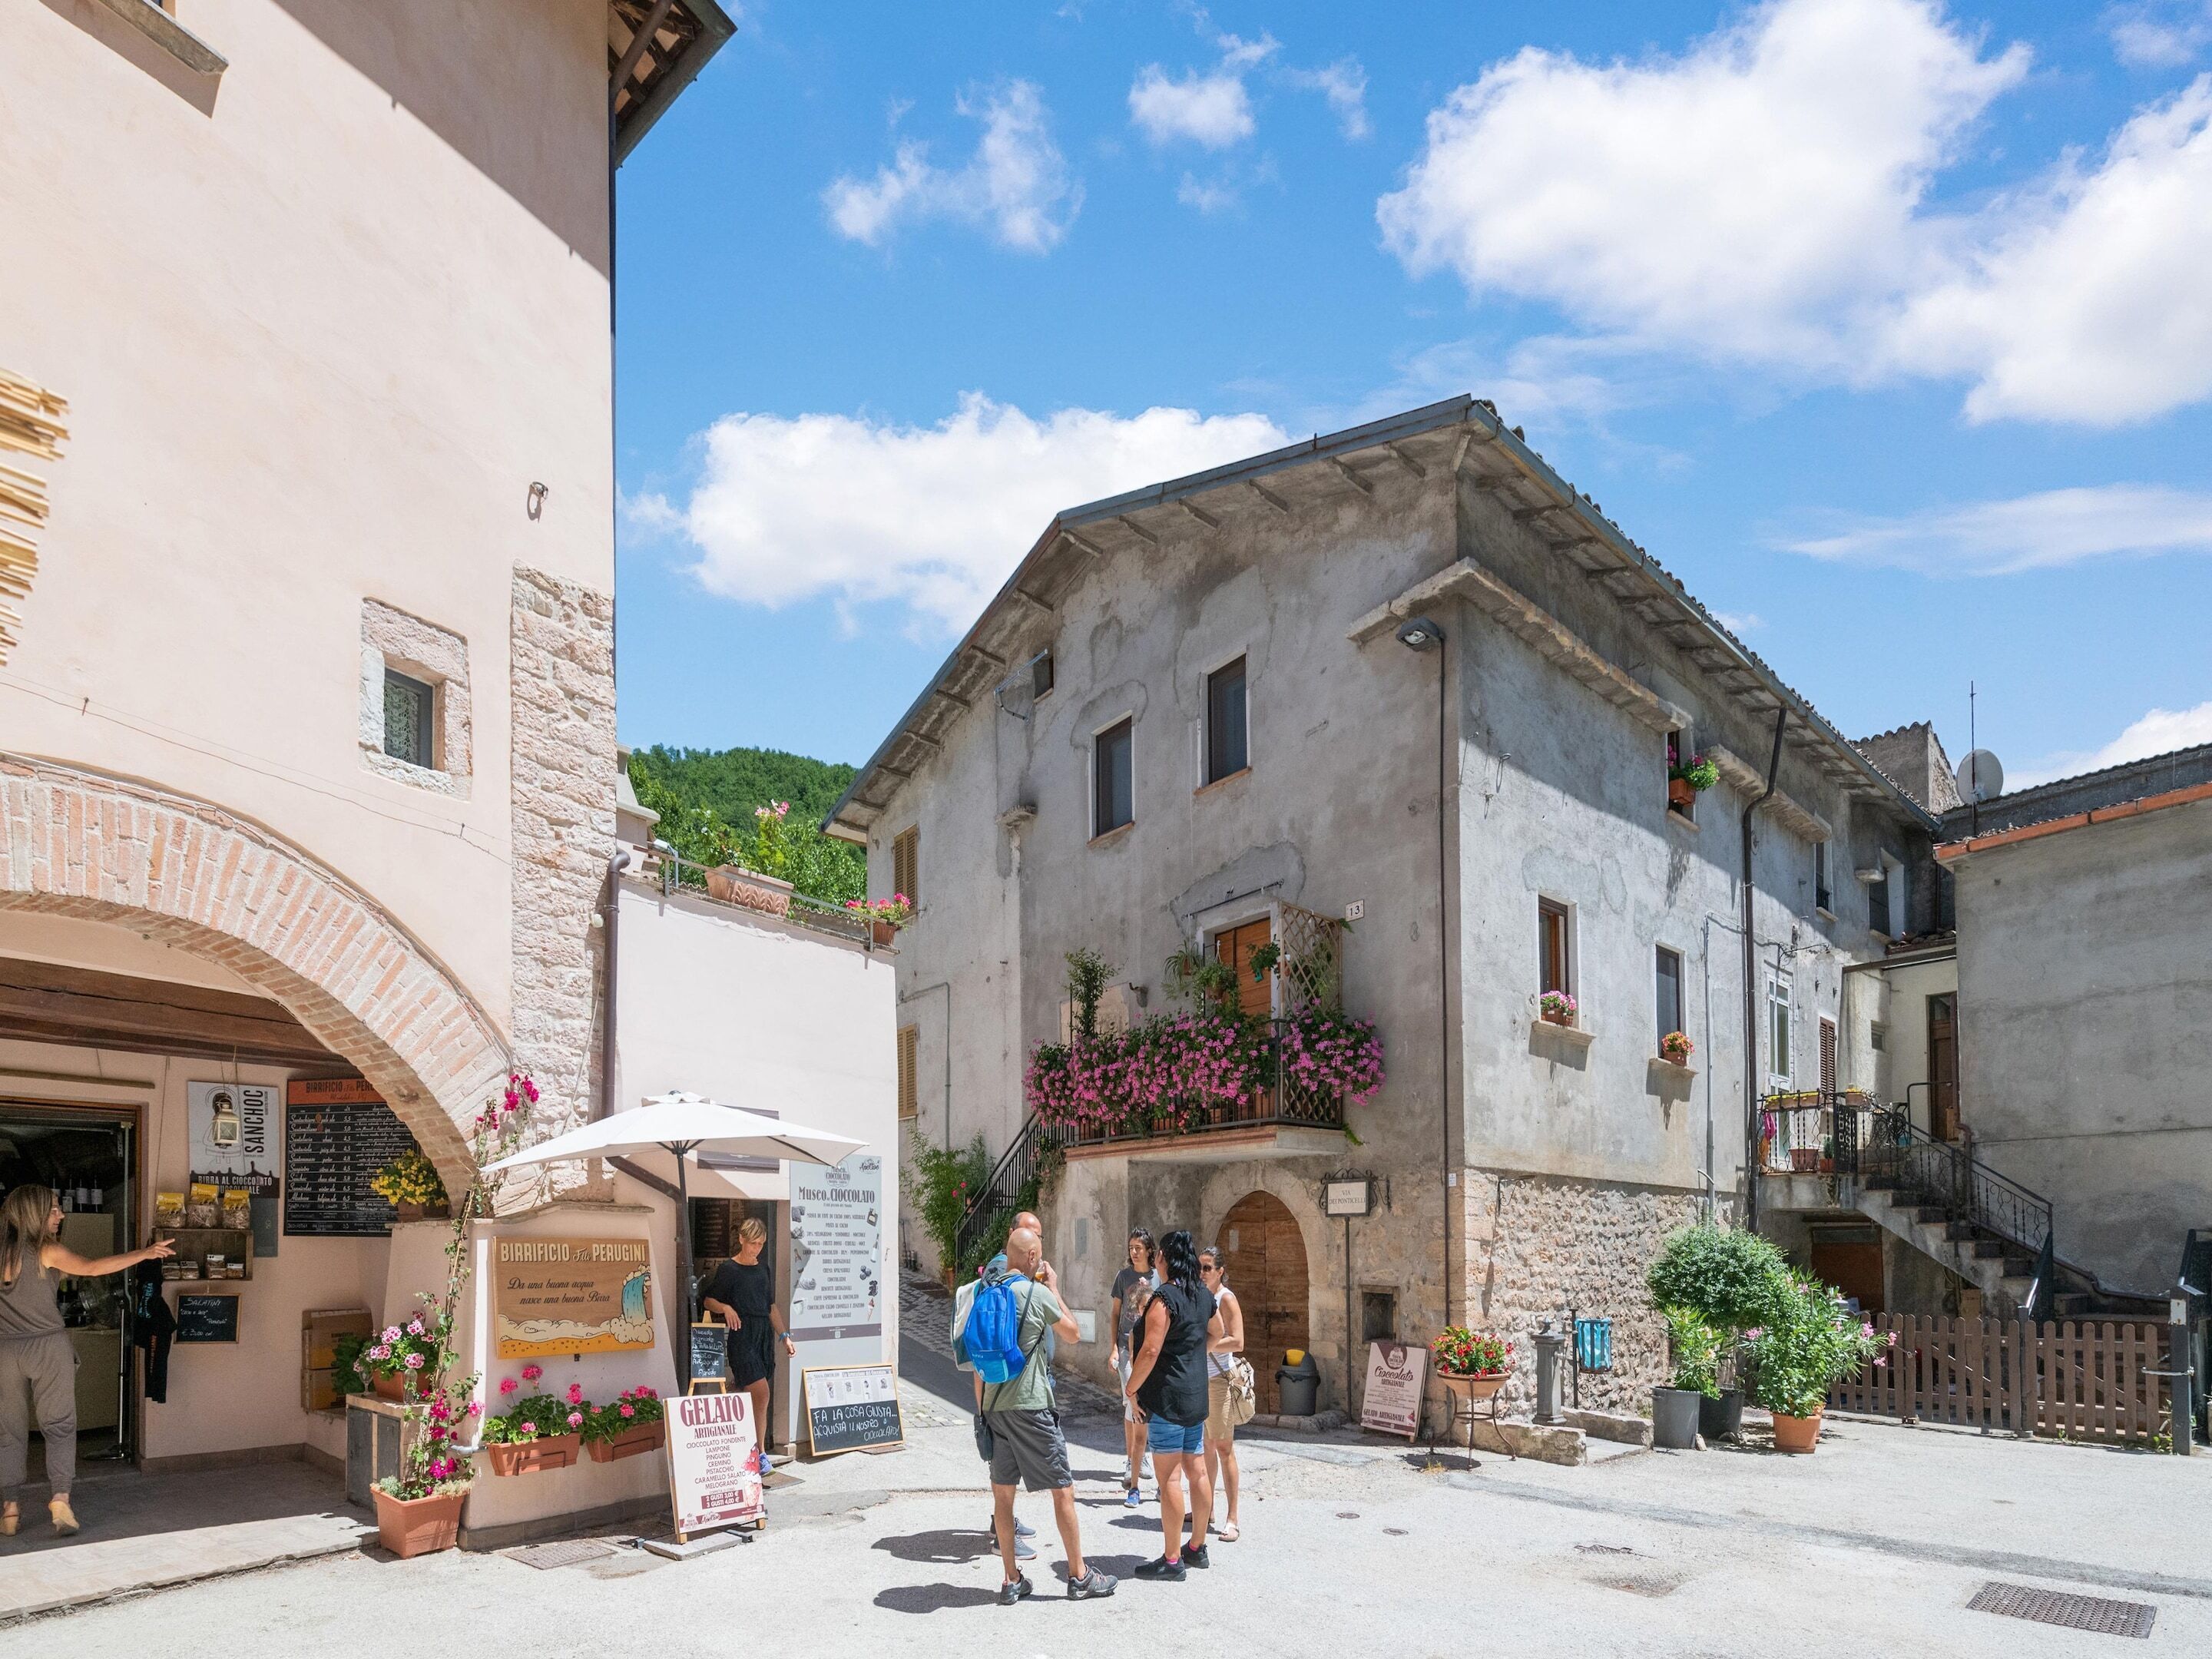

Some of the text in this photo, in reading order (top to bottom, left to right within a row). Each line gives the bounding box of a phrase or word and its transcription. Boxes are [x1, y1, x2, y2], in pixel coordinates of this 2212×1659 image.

[1349, 905, 1360, 916] 13
[306, 1081, 343, 1094] BIRRIFICIO
[243, 1089, 264, 1154] SANCHOC
[197, 1175, 219, 1184] BIRRA
[222, 1176, 230, 1185] AL
[830, 1187, 875, 1204] CIOCCOLATO
[1337, 1197, 1366, 1205] PONTICELLI
[501, 1242, 570, 1263] BIRRIFICIO
[591, 1243, 646, 1263] PERUGINI
[507, 1277, 594, 1291] Da una buona acqua
[519, 1290, 611, 1305] nasce una buona Birra
[1374, 1365, 1414, 1382] Cioccolato
[680, 1395, 744, 1427] GELATO
[813, 1409, 828, 1424] FA
[833, 1408, 843, 1421] LA
[845, 1406, 864, 1419] COSA
[1363, 1408, 1378, 1417] GELATO
[1379, 1411, 1405, 1422] ARTIGIANALE
[694, 1424, 737, 1439] ARTIGIANALE
[813, 1419, 879, 1440] ACQUISTA IL NOSTRO
[686, 1435, 747, 1449] CIOCCOLATO FONDENTE
[705, 1445, 730, 1454] LAMPONE
[706, 1452, 732, 1461] PINGUINO
[706, 1465, 735, 1475] PISTACCHIO
[707, 1459, 731, 1468] CREMINO
[694, 1471, 747, 1485] CARAMELLO SALATO
[705, 1479, 738, 1490] MELOGRANO
